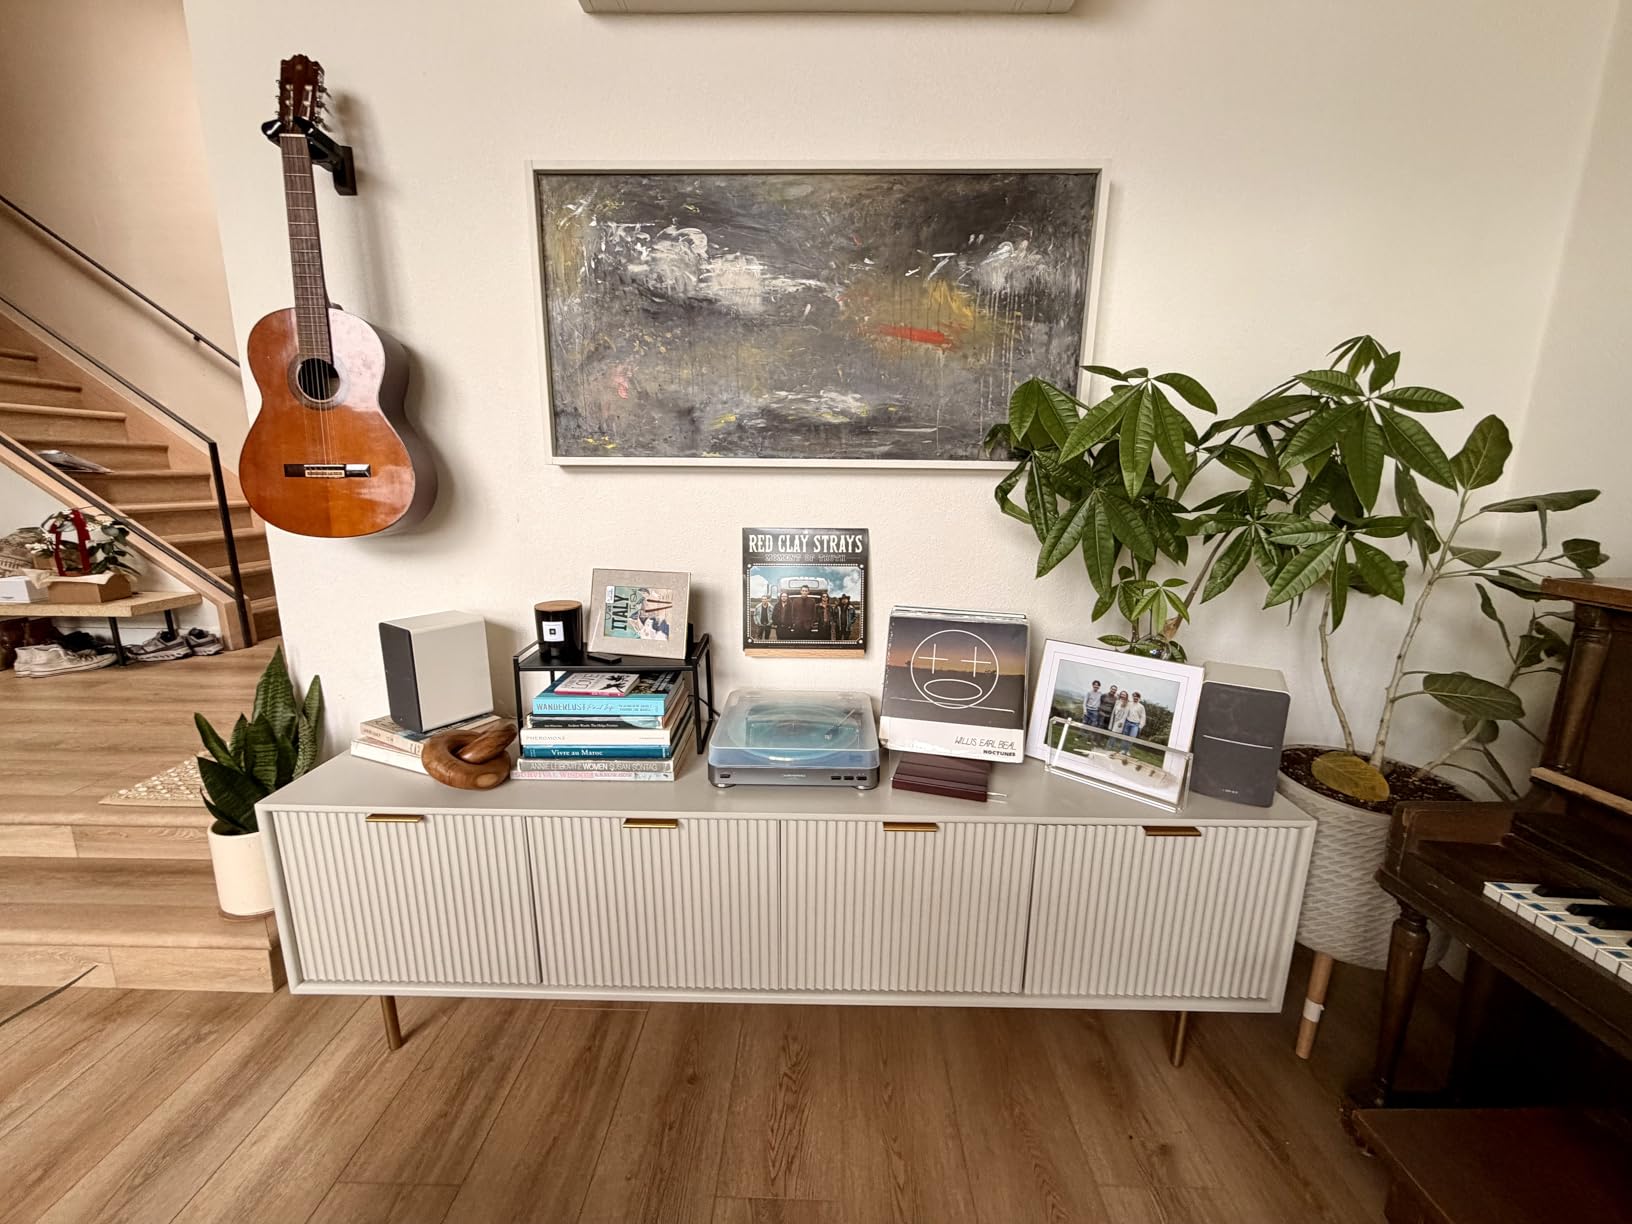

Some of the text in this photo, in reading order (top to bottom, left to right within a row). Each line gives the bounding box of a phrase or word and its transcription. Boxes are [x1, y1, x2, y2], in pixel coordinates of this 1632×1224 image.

[749, 534, 863, 553] RED CLAY STRAYS
[611, 594, 629, 631] ITALY
[536, 703, 586, 711] WANDERLUST
[954, 736, 1016, 750] WILLIS EARL BEAL
[983, 749, 1016, 757] NOCTUNES
[530, 763, 550, 771] ANNIE
[582, 763, 608, 771] WOMEN
[609, 763, 631, 771] SUSAN
[631, 763, 657, 771] SONTAG
